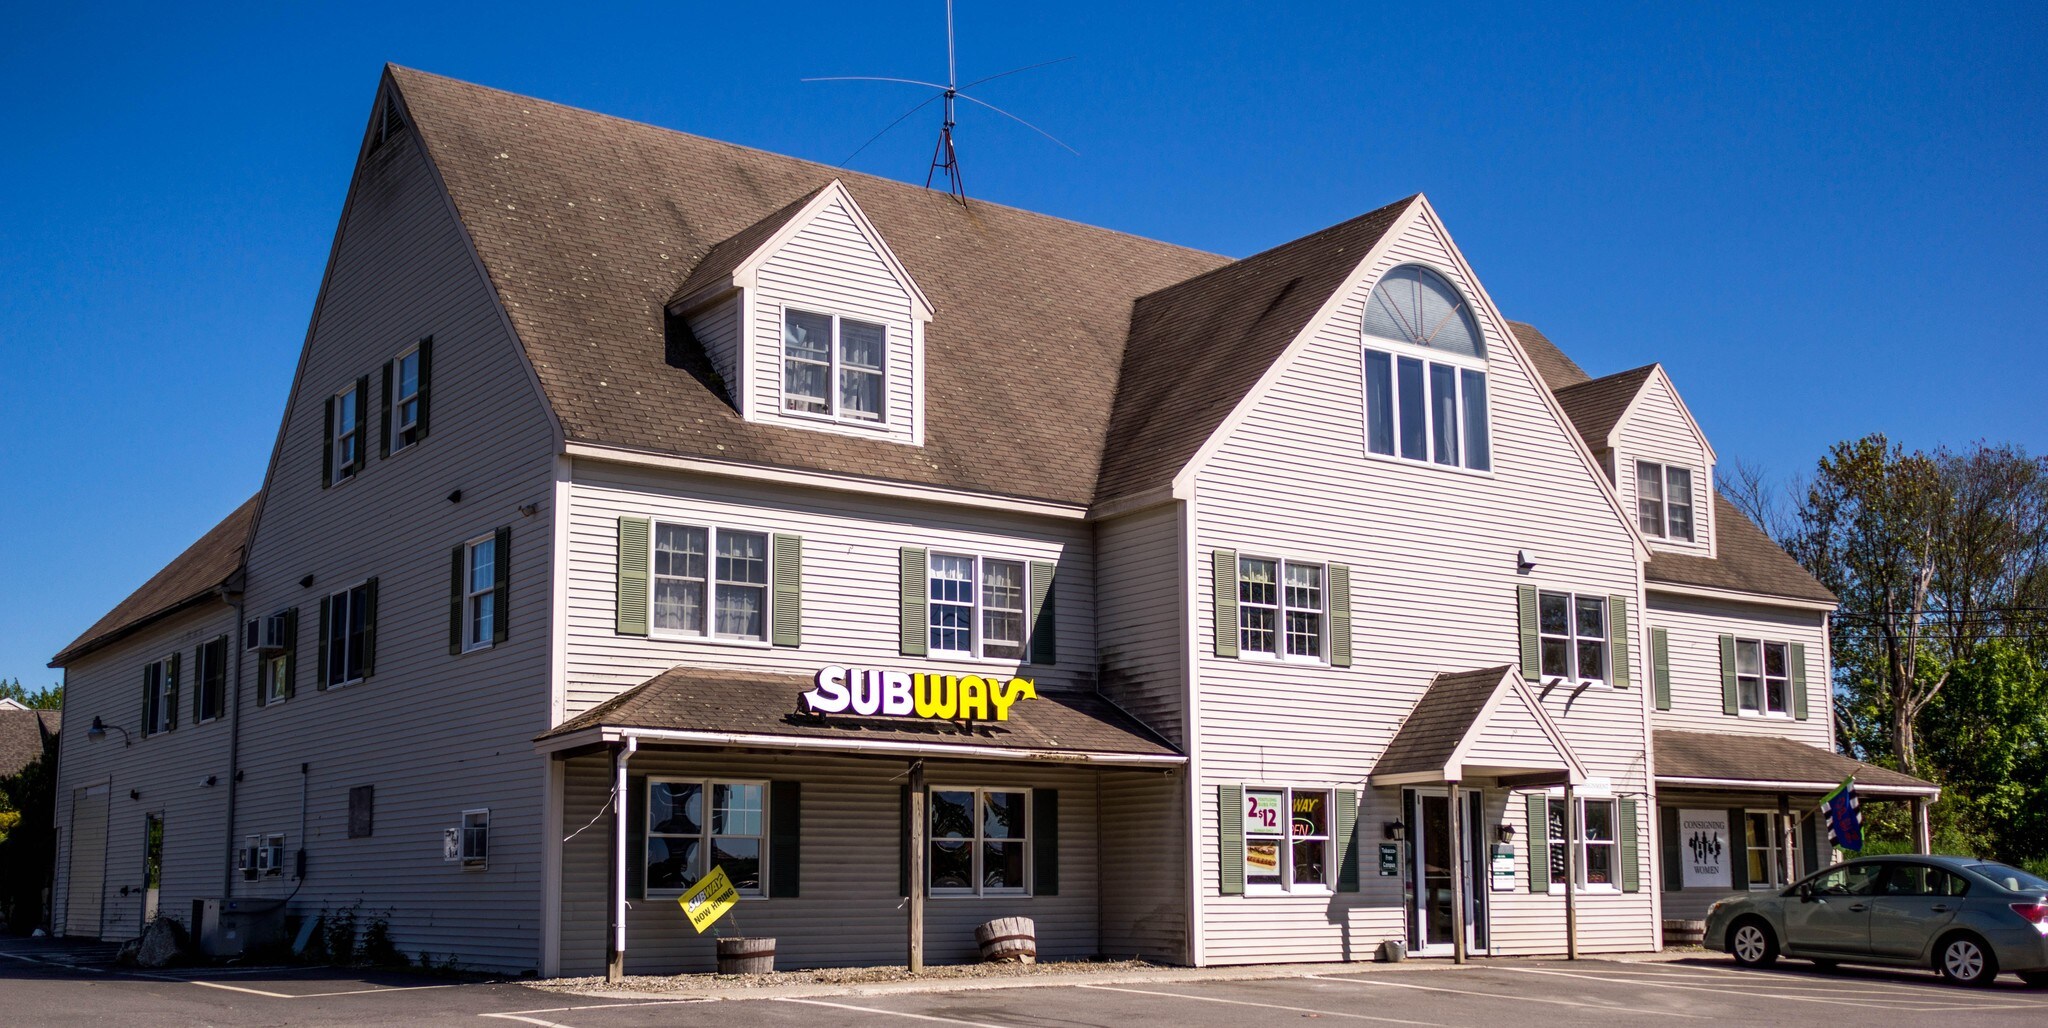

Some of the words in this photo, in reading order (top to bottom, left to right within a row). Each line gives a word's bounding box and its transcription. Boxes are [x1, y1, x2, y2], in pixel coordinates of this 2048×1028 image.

[803, 665, 1038, 721] SUBWAY
[1248, 797, 1257, 817] 2
[1259, 809, 1276, 826] $12
[1683, 821, 1725, 830] CONSIGNING
[1694, 866, 1720, 874] WOMEN
[688, 873, 724, 913] SUBWAY
[694, 907, 711, 924] NOW
[711, 887, 734, 910] HIRING
